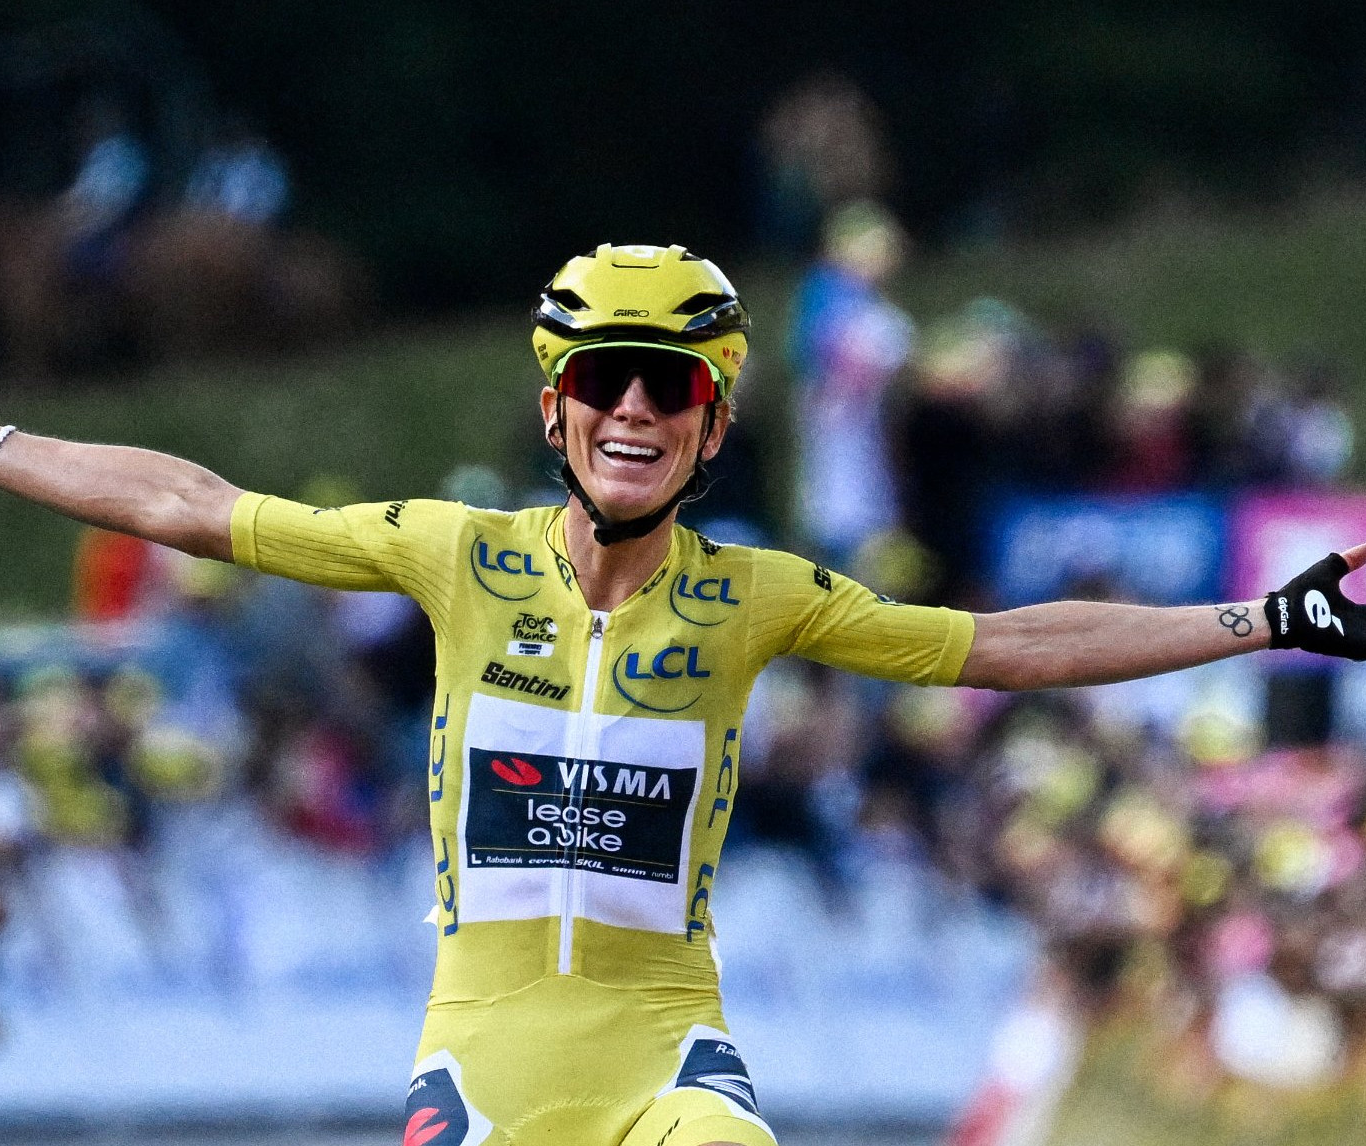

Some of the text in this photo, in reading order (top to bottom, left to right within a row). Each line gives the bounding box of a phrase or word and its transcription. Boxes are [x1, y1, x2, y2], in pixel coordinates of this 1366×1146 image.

[613, 308, 650, 318] GIRO
[478, 541, 545, 577] LCL
[677, 574, 741, 606] LCL
[480, 661, 571, 701] Santini
[624, 645, 711, 681] LCL
[430, 693, 449, 803] LCL
[557, 761, 671, 800] VISMA
[707, 728, 738, 829] LCL
[527, 798, 627, 828] lease
[485, 855, 523, 864] Rabobank
[575, 858, 605, 870] SKIL
[437, 837, 458, 937] LCL
[686, 862, 715, 943] LCL
